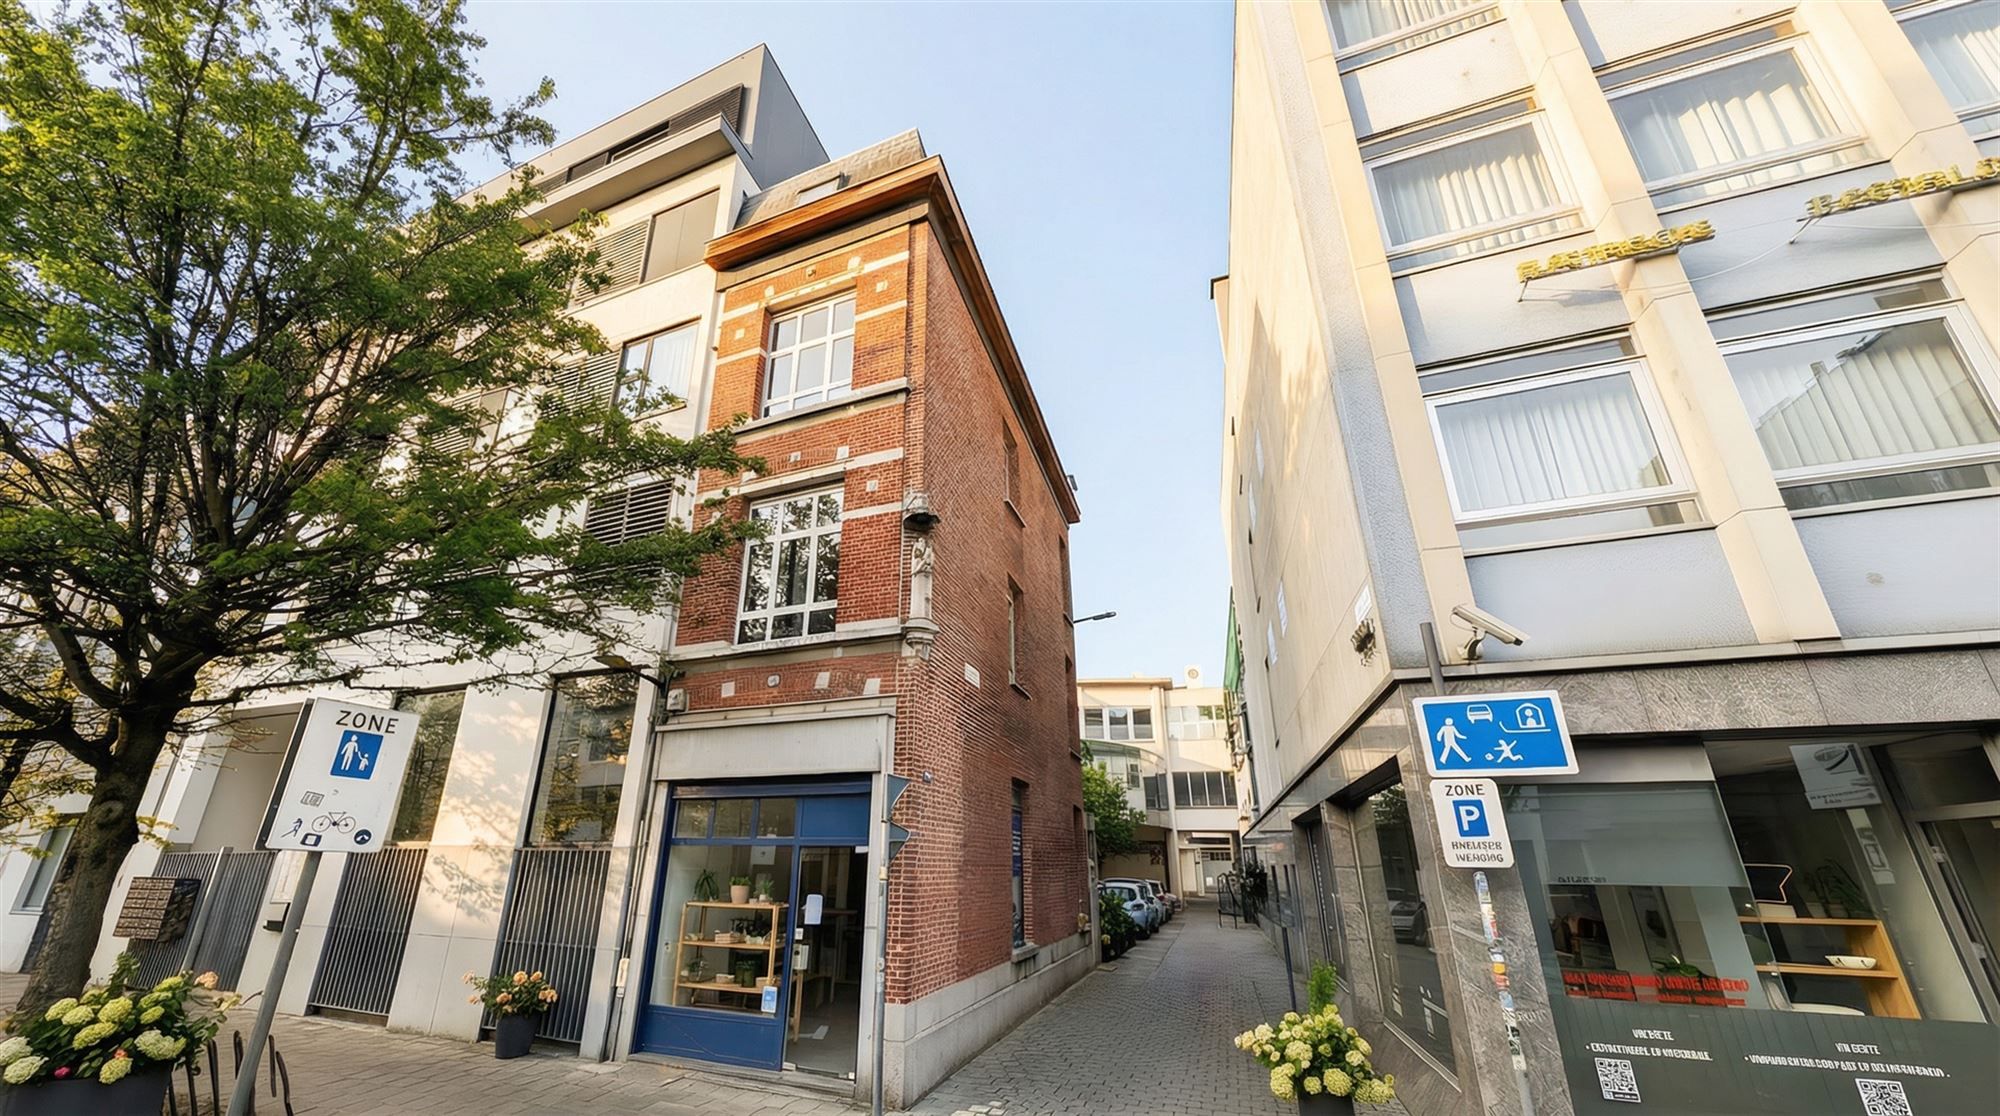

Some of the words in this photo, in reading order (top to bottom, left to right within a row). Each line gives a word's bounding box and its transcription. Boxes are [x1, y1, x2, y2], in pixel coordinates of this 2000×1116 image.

[335, 710, 399, 734] ZONE
[1444, 784, 1485, 797] ZONE
[1458, 805, 1480, 831] P
